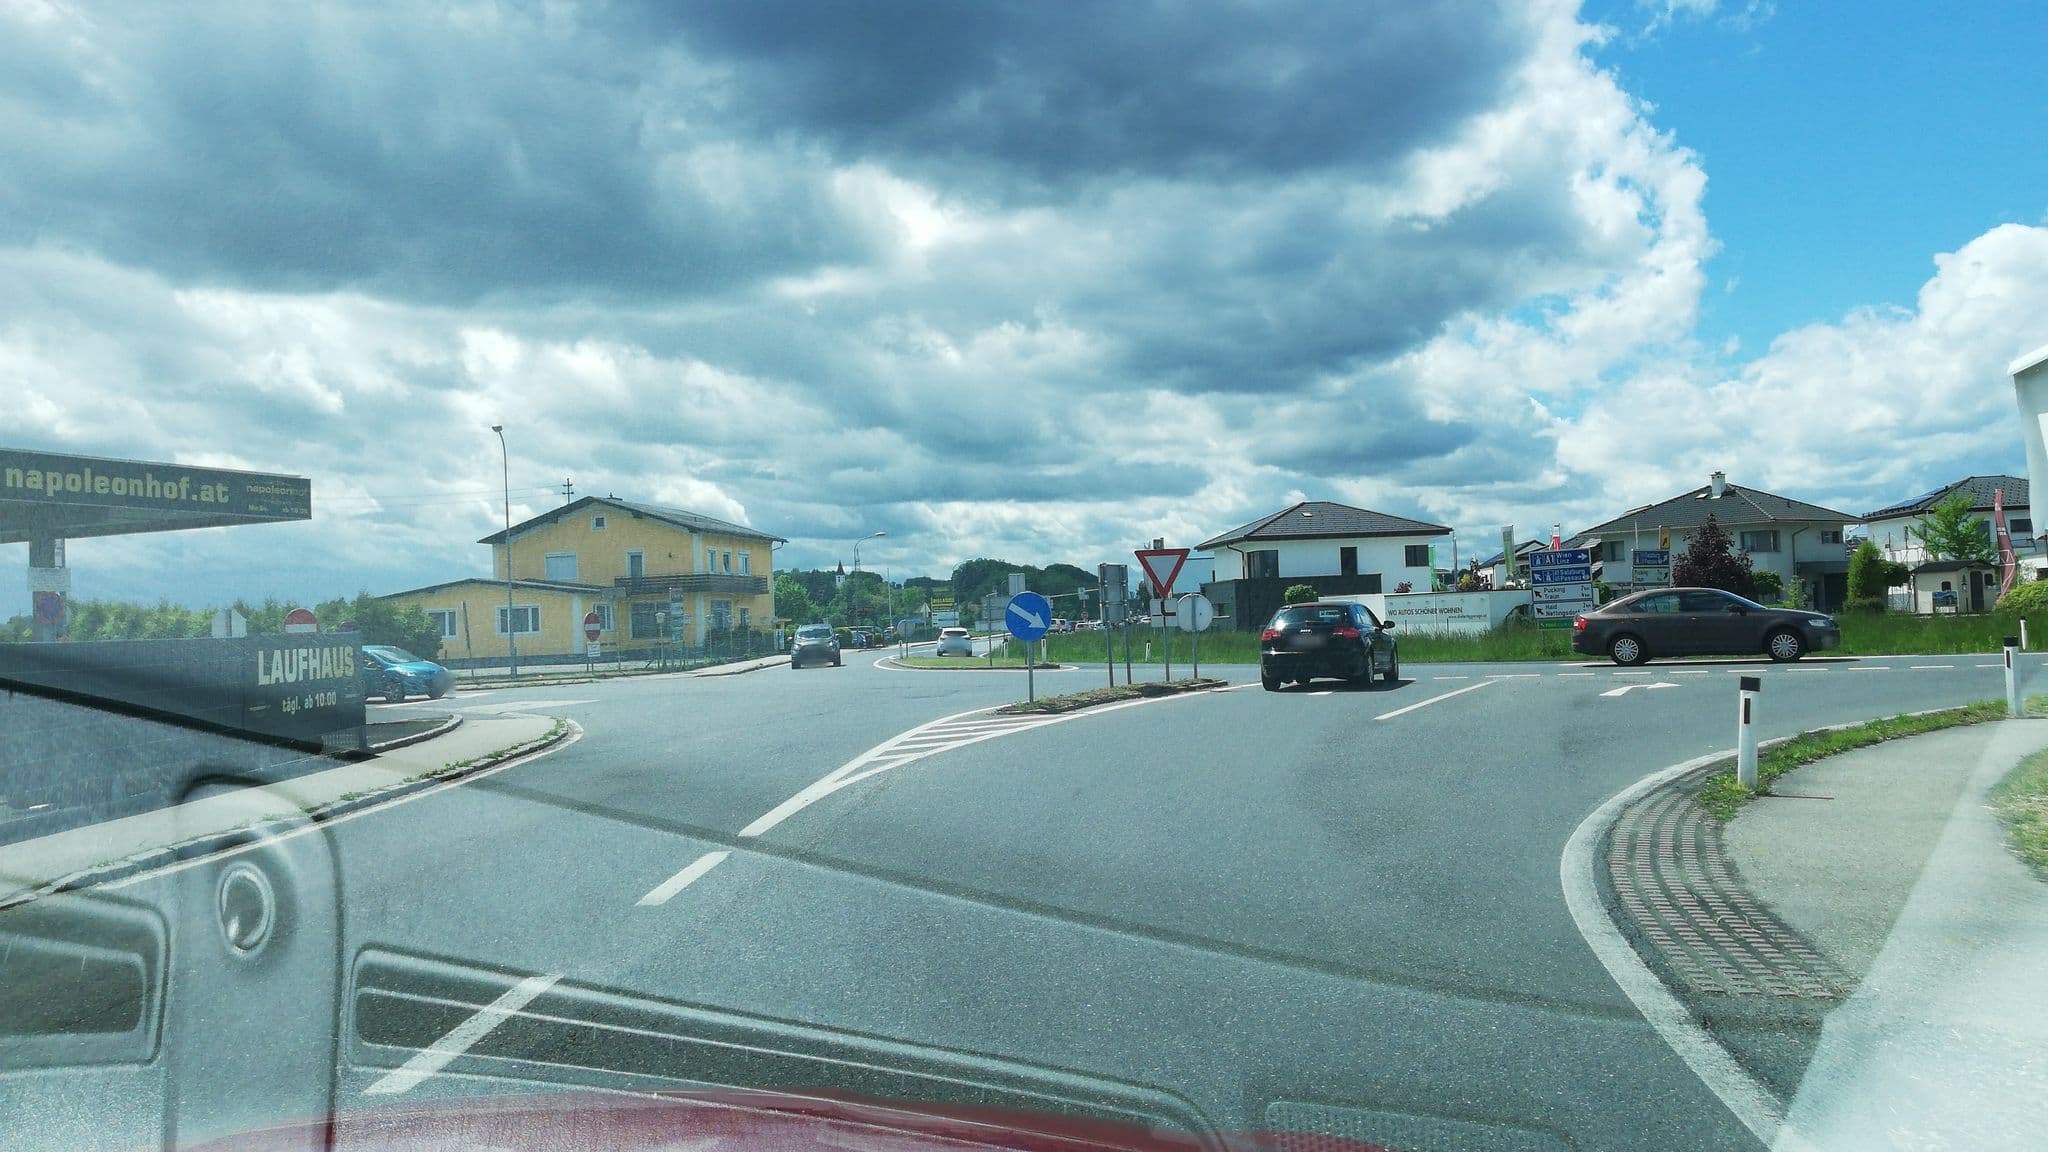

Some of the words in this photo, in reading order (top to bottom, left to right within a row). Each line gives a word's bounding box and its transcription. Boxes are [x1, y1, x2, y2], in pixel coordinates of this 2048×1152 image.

[5, 466, 229, 503] napoleonhof.at
[1556, 551, 1572, 559] Wien
[1439, 606, 1463, 615] WOHNEN
[258, 646, 354, 685] LAUFHAUS
[282, 696, 301, 715] tägl.
[304, 694, 313, 709] ab
